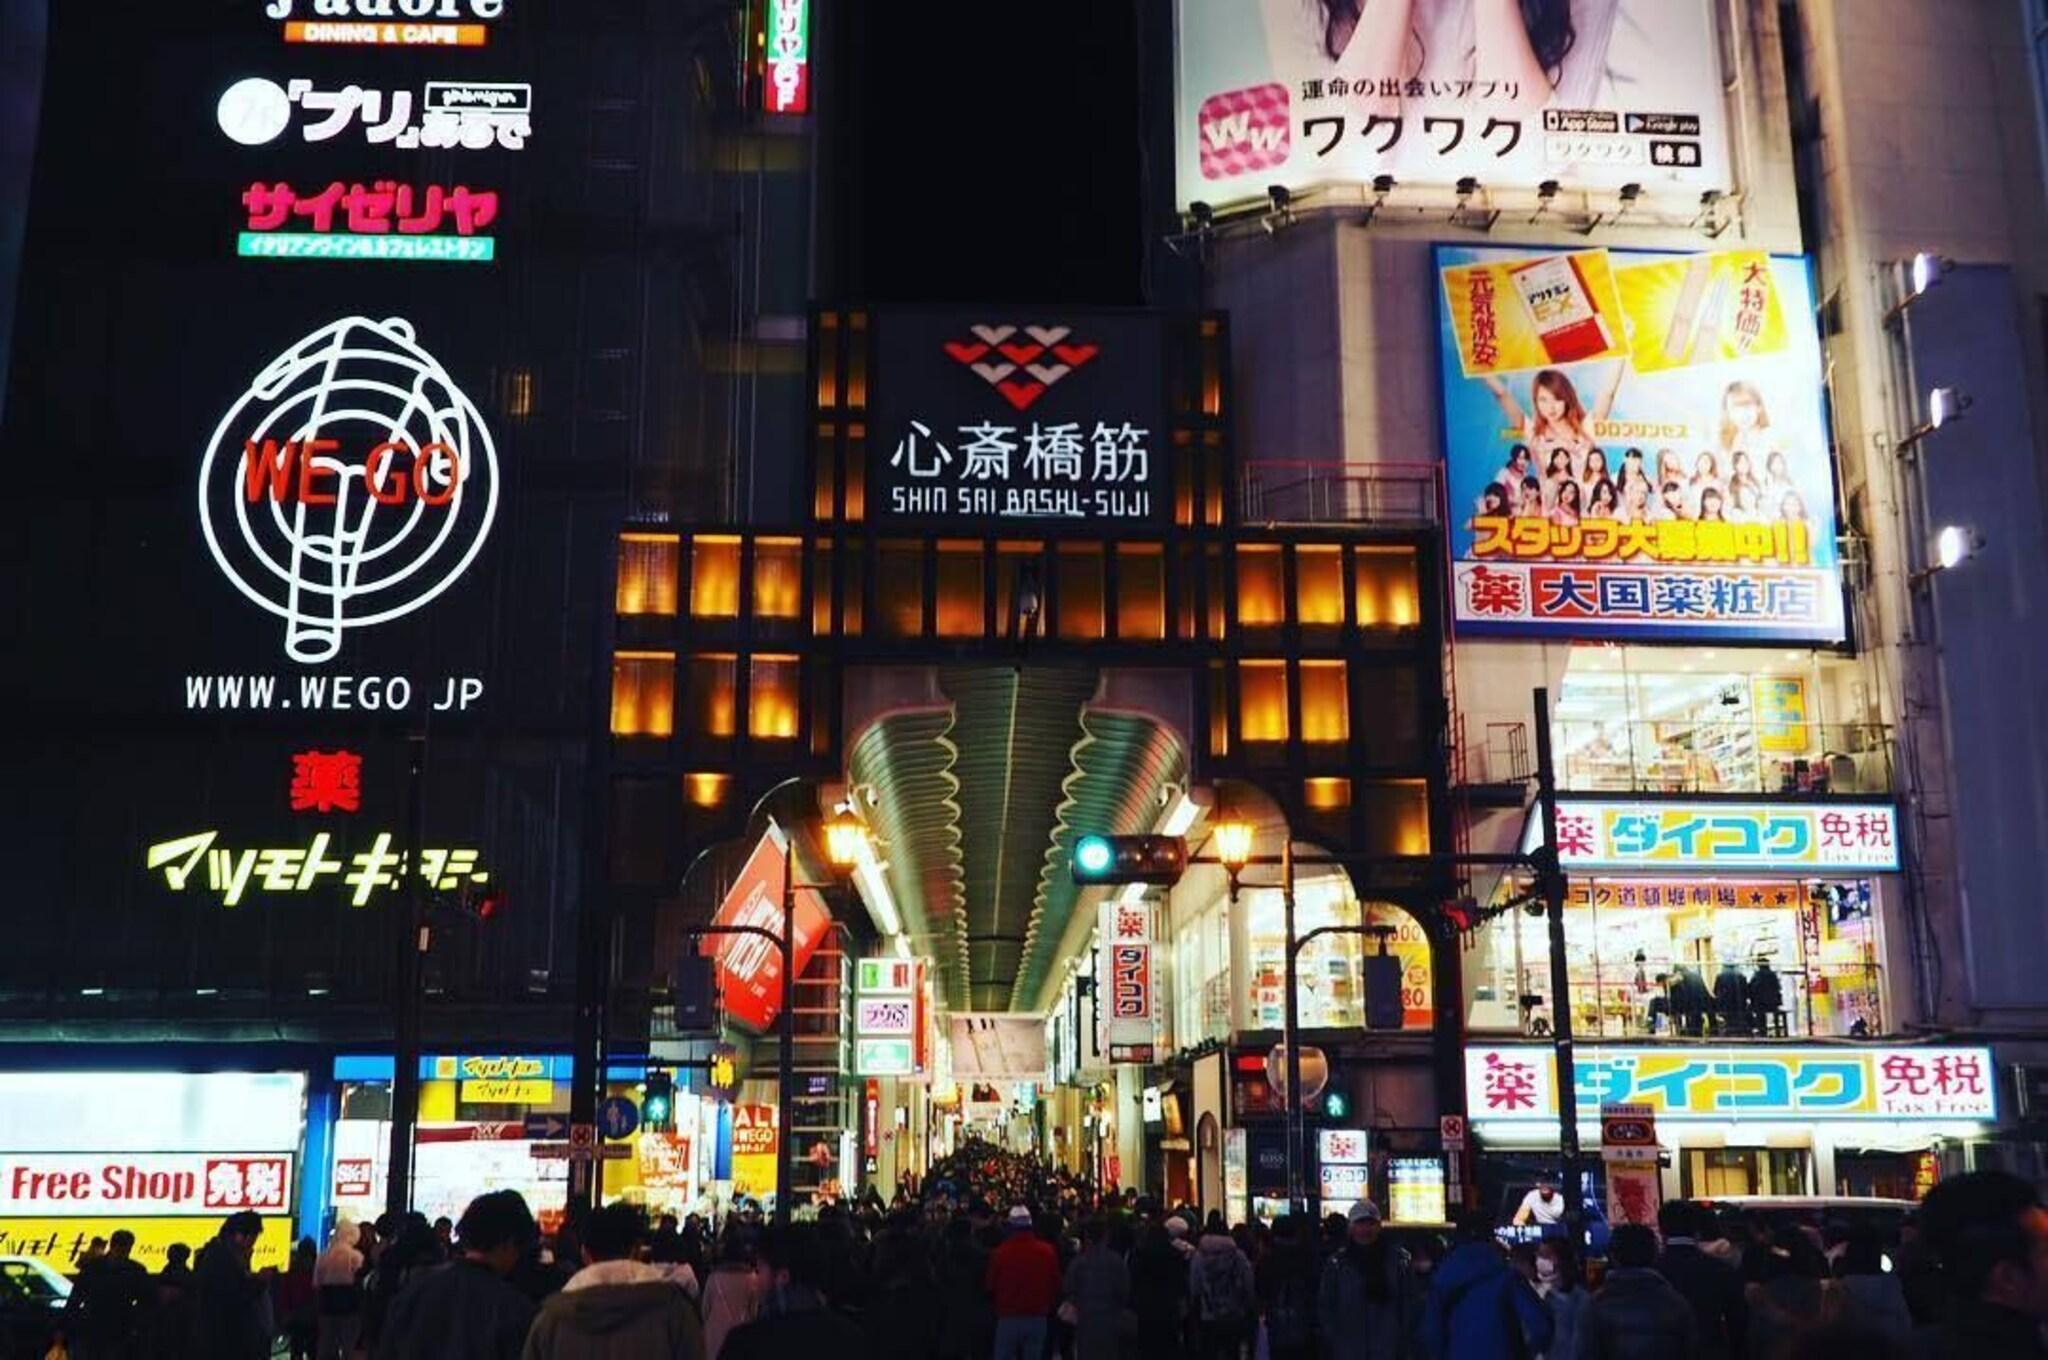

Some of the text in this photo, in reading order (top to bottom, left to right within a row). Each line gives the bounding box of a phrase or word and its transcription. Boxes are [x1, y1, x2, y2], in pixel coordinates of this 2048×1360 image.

[304, 24, 378, 42] DINING
[1302, 78, 1519, 101] 運命の出会いアプリ
[1303, 114, 1522, 157] ワクワク
[242, 180, 498, 235] サイゼリヤ
[890, 420, 1150, 482] 心斎橋筋
[892, 486, 947, 513] SHIN
[1470, 565, 1818, 618] 薬 大国薬粧店
[290, 750, 363, 812] 薬
[1554, 808, 1891, 857] 薬 ダイコク 免税
[1117, 906, 1144, 938] 薬
[1484, 1053, 1985, 1111] 薬 ダイコク 免税
[1885, 1100, 1990, 1114] Tax Free
[11, 1162, 283, 1205] Free Shop 免税
